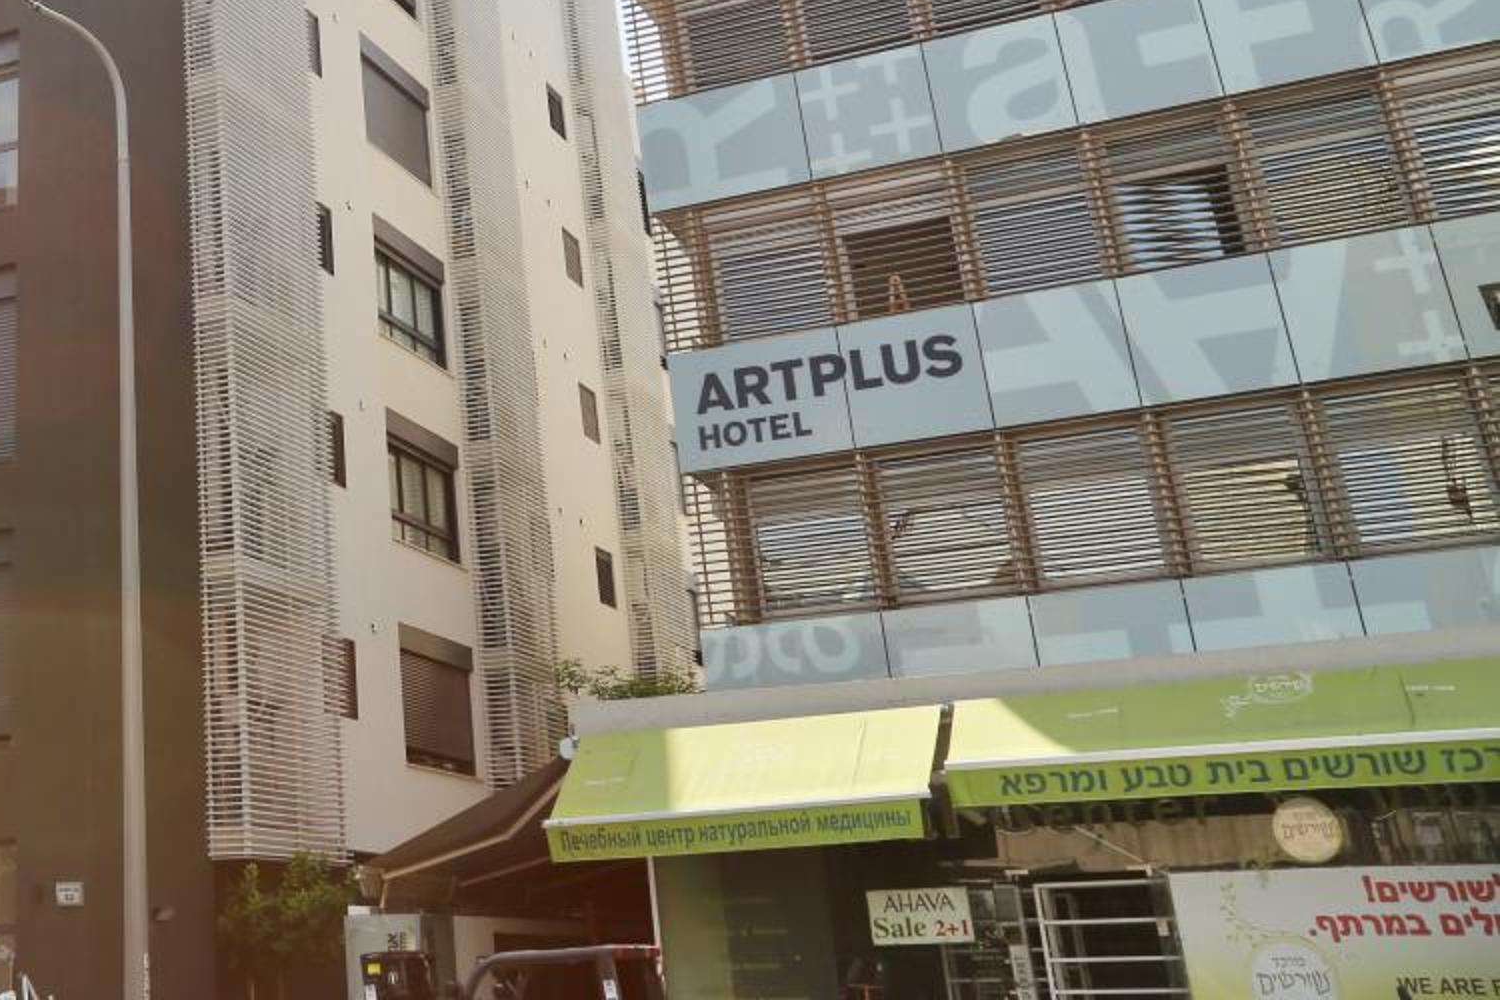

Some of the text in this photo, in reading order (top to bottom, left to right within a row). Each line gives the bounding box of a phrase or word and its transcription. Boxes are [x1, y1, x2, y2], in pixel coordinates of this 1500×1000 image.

[697, 335, 964, 415] ARTPLUS
[699, 412, 813, 451] HOTEL
[1120, 763, 1193, 793] טבע
[1206, 759, 1271, 785] בית
[1283, 750, 1426, 781] שורשים
[1000, 769, 1108, 796] ומרפא
[645, 824, 695, 849] центр
[700, 811, 811, 845] натуральной
[817, 808, 912, 833] медицины
[884, 892, 955, 914] AHAVA
[873, 917, 971, 939] Sale 2+1
[1310, 913, 1432, 943] במרתף.
[1441, 977, 1486, 995] ARE
